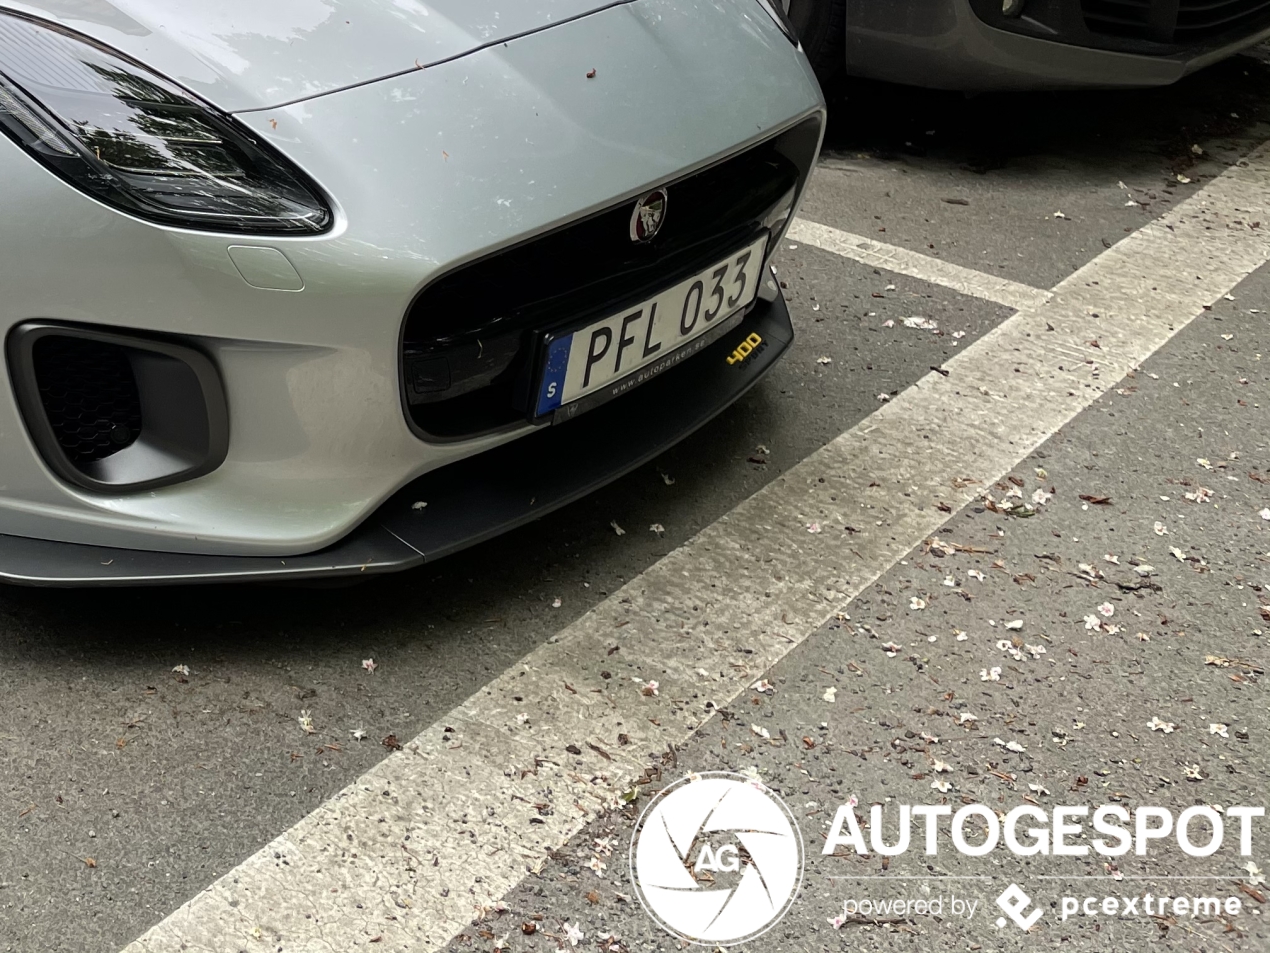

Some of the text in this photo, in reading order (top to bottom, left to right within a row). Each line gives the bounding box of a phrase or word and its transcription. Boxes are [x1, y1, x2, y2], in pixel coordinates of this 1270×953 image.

[582, 250, 752, 388] PFL 033
[612, 339, 706, 395] www.autoparken.se
[725, 332, 762, 365] 400
[546, 381, 557, 398] S
